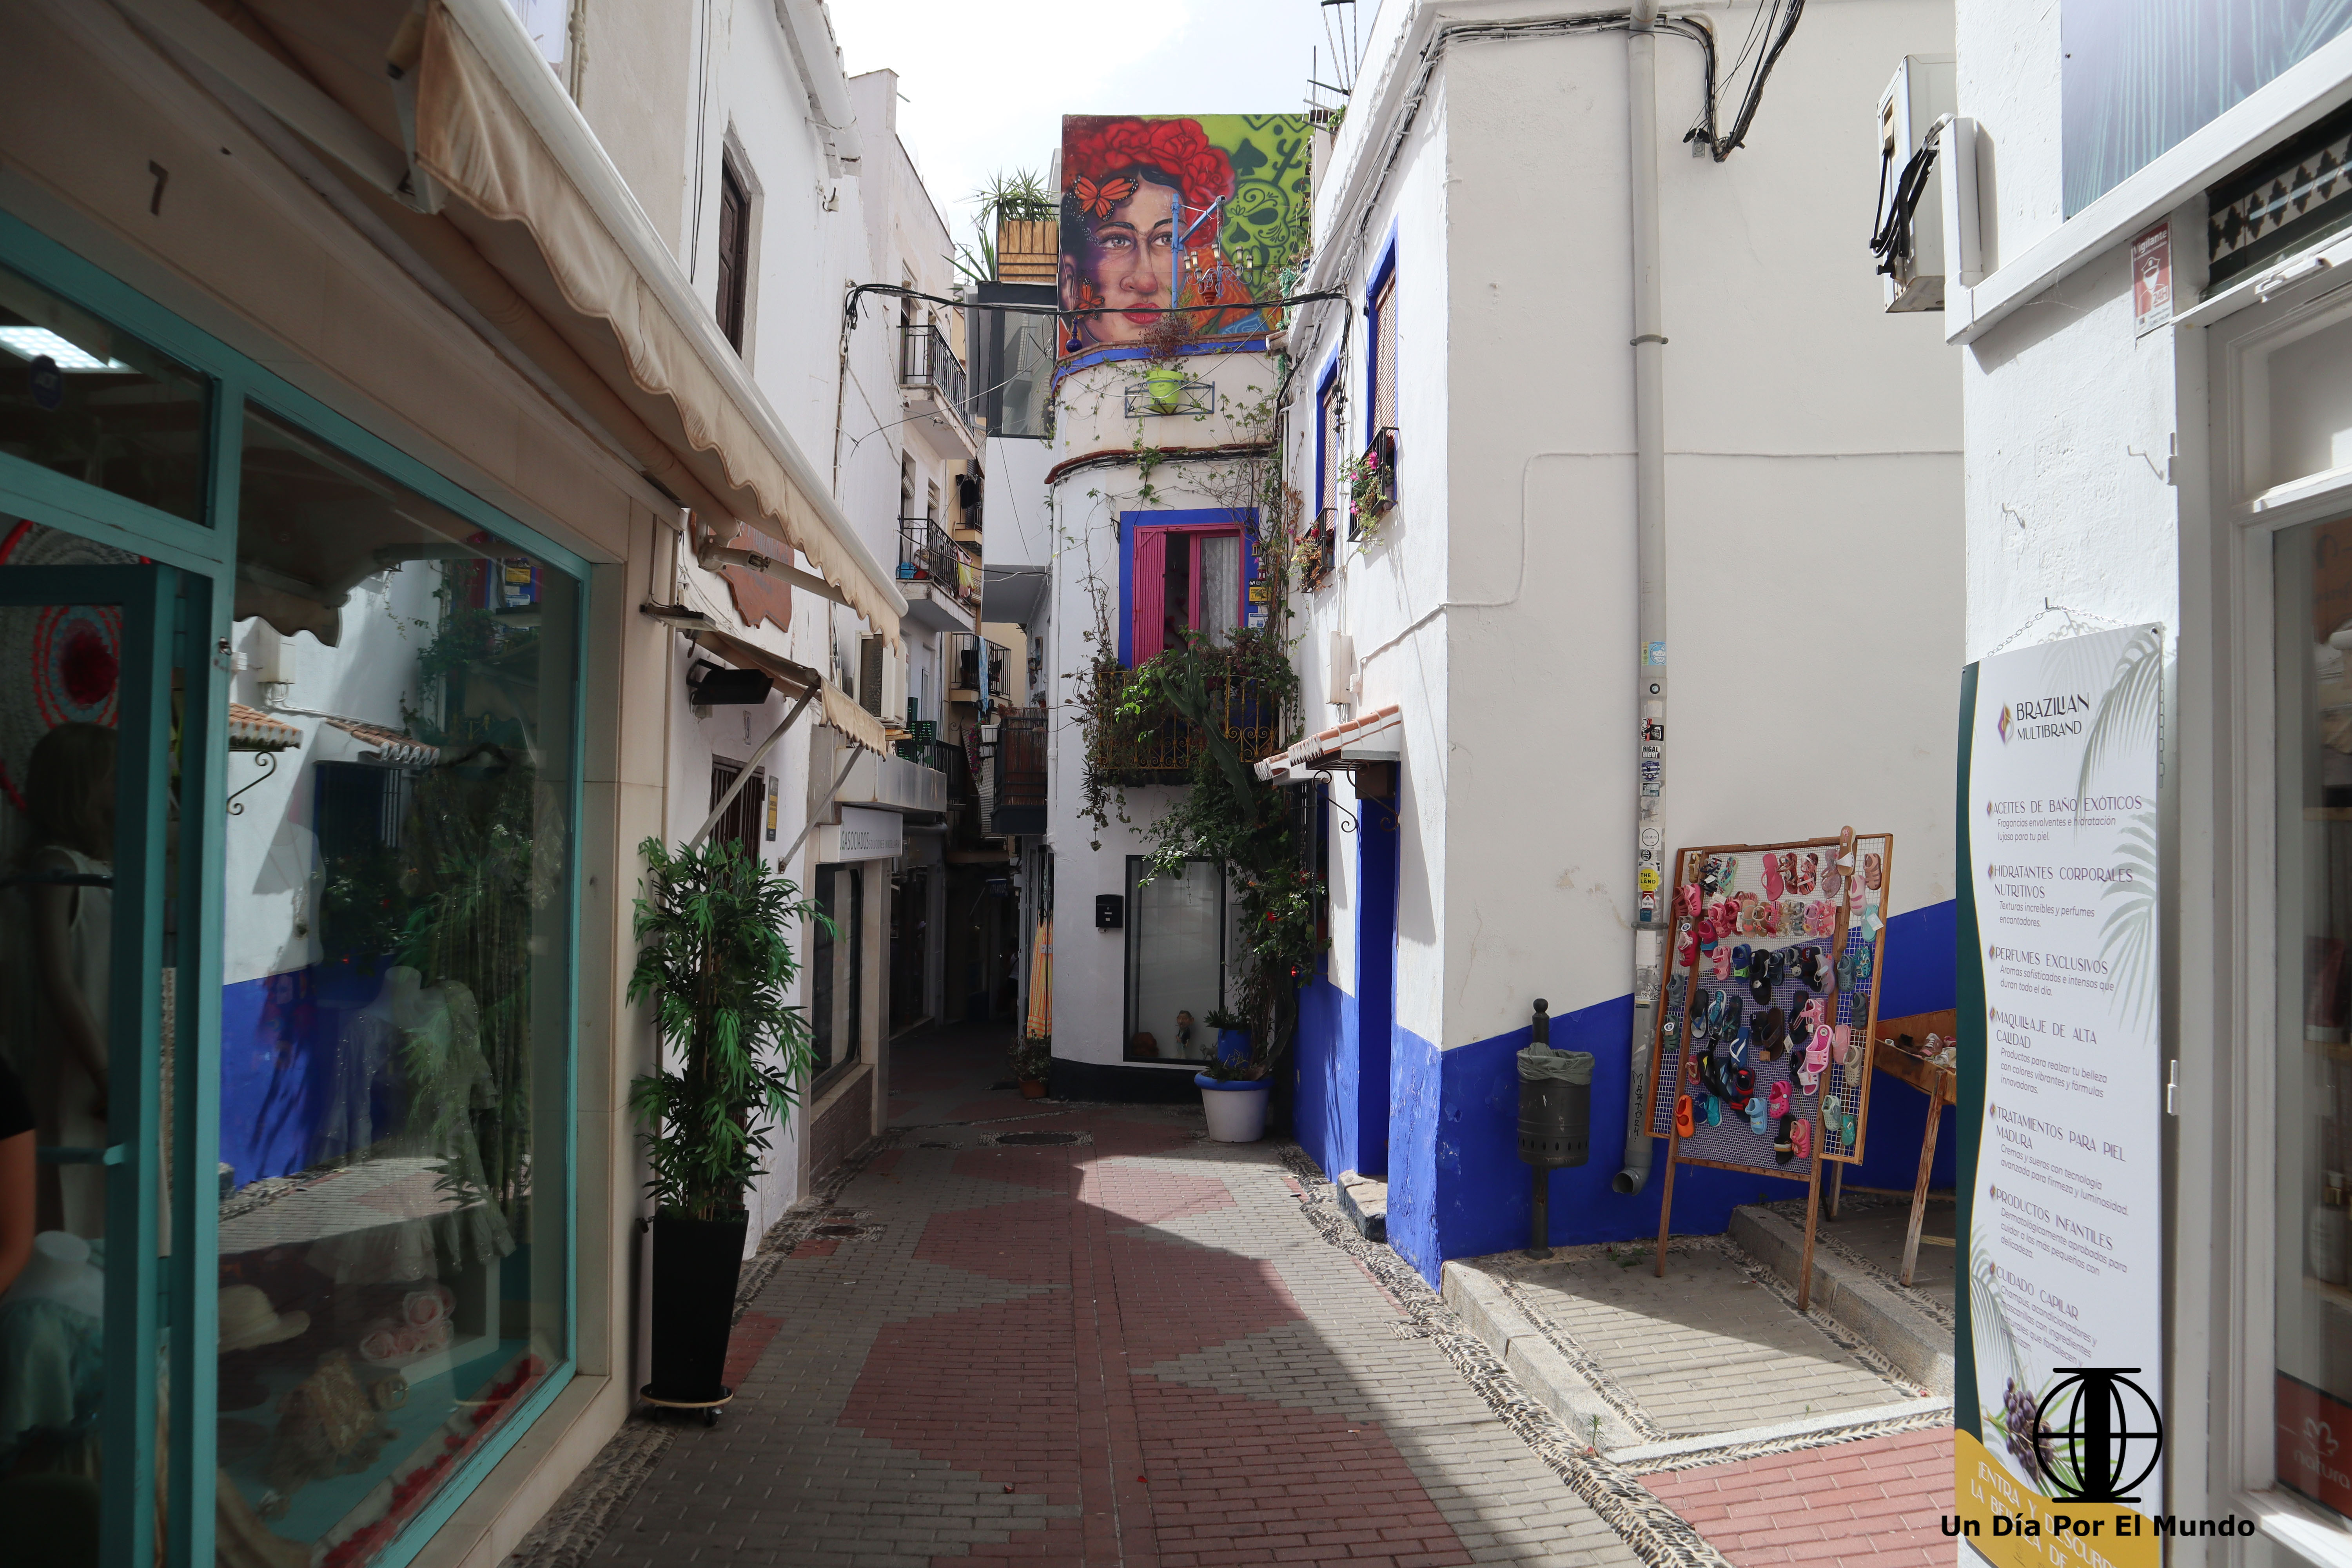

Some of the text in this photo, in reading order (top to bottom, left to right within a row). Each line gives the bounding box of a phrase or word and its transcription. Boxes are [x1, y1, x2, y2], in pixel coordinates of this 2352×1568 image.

[149, 159, 169, 216] 7
[2133, 230, 2167, 254] Vigilante
[2153, 288, 2167, 304] 24H
[2016, 692, 2090, 720] BRAZILIAN
[746, 717, 750, 739] 9
[2017, 720, 2082, 741] MULTIBRAND
[1993, 795, 2142, 815] ACEITES DE BAÑO EXÓTICOS
[1998, 818, 2028, 829] Fragancias
[2029, 818, 2066, 826] envolventes
[2074, 815, 2116, 826] hidratación
[840, 831, 869, 850] GASOCIADOS
[1998, 832, 2013, 842] lujosa
[2014, 833, 2028, 842] para
[2037, 831, 2050, 842] piel.
[1994, 865, 2133, 882] HIDRATANTES CORPORALES
[1995, 884, 2045, 898] NUTRITIVOS
[2000, 901, 2023, 911] Texturas
[2025, 903, 2054, 915] increíbles
[2061, 906, 2095, 917] perfumes
[2000, 916, 2041, 927] encantadores.
[1996, 947, 2108, 975] PERFUMES EXCLUSIVOS
[2000, 965, 2023, 976] Aromas
[2024, 969, 2061, 983] sofisticados
[2068, 976, 2098, 988] intensos
[2100, 982, 2114, 993] que
[2000, 979, 2053, 996] duran todo el día.
[1996, 1011, 2097, 1045] MAQUILLAJE DE ALTA
[1996, 1029, 2031, 1049] CALIDAD
[2001, 1047, 2107, 1083] Productos para realzar tu belleza
[2001, 1063, 2103, 1098] con colores vibrantes y fórmulas
[2001, 1075, 2038, 1094] innovadoras.
[1996, 1106, 2127, 1162] TRATAMIENTOS PARA PIEL
[1996, 1125, 2033, 1150] MADURA
[2001, 1144, 2023, 1160] Cremas
[2029, 1157, 2050, 1171] sueros
[2051, 1165, 2063, 1176] con
[2065, 1169, 2102, 1190] tecnología
[2001, 1159, 2129, 1216] avanzada para firmeza y luminosidad.
[1996, 1188, 2113, 1251] PRODUCTOS INFANTILES
[2001, 1207, 2127, 1274] Dermatológicamente aprobados para
[2001, 1235, 2034, 1259] delicadeza.
[2001, 1222, 2020, 1237] cuidar
[2036, 1240, 2050, 1252] más
[2051, 1247, 2085, 1269] pequeños
[2086, 1263, 2100, 1276] con
[1996, 1265, 2078, 1321] CUIDADO CAPILAR
[2001, 1285, 2098, 1347] Champús, acondicionadores y
[2001, 1300, 2092, 1358] mascarillas con ingredientes
[2001, 1314, 2083, 1368] naturales que fortalecen y
[2293, 1449, 2350, 1490] natura
[1971, 1478, 1984, 1504] LA
[1991, 1494, 2042, 1553] BELLZA
[2027, 1499, 2037, 1519] Y
